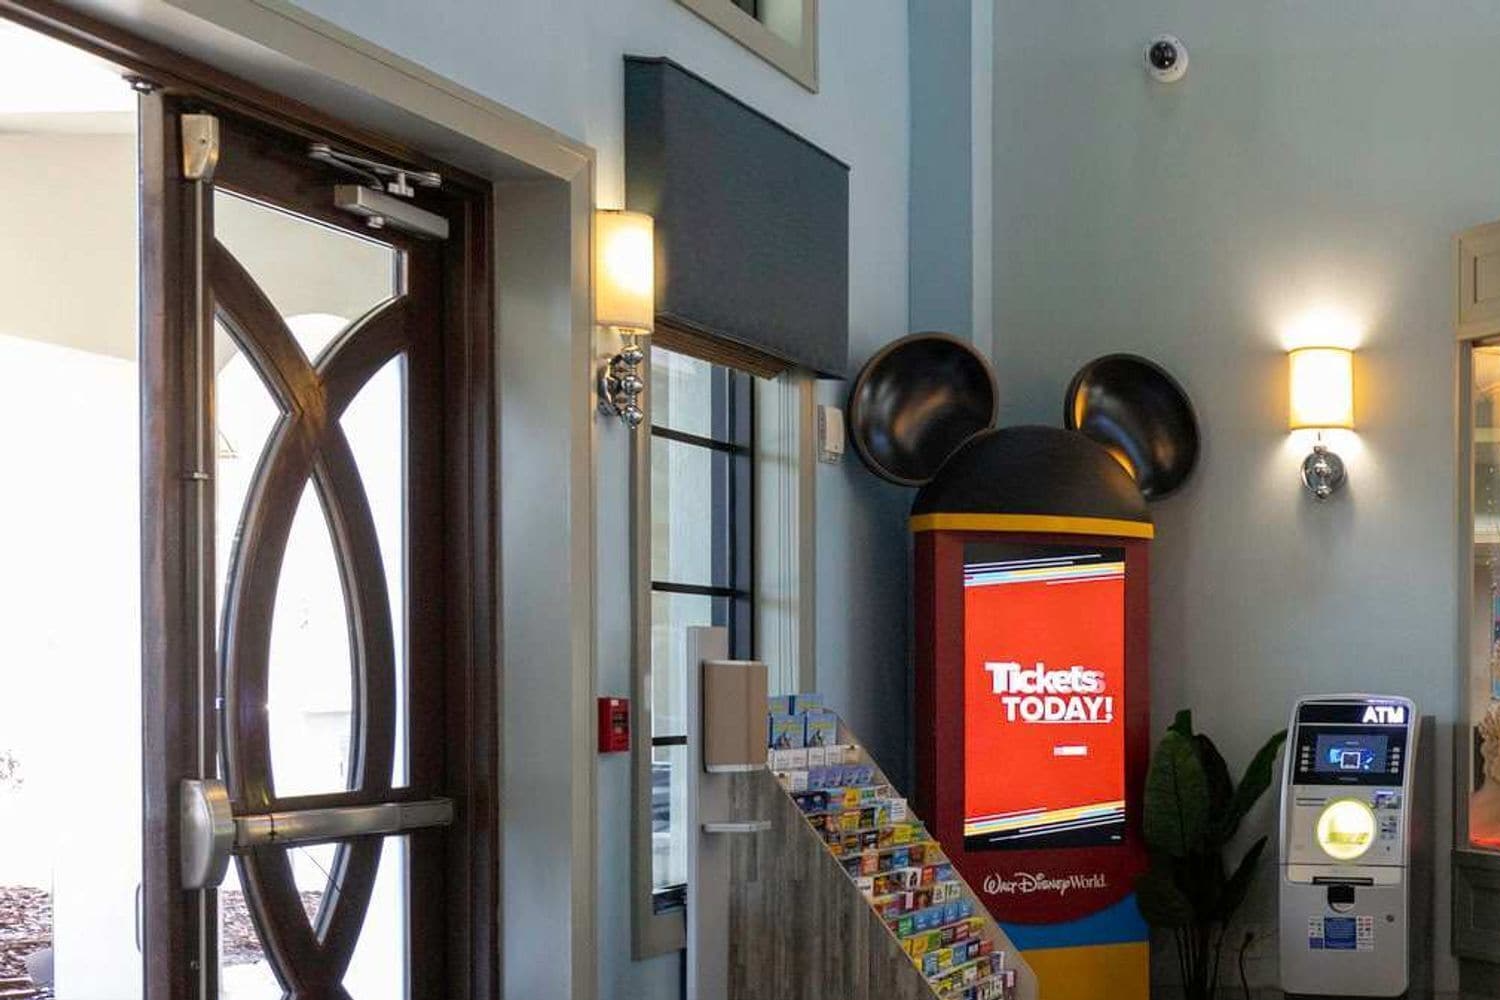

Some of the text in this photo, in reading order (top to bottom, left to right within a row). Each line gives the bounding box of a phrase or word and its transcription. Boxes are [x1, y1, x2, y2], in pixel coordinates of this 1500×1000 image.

[984, 661, 1106, 694] Tickets
[1001, 695, 1114, 722] TODAY!
[1362, 705, 1404, 723] ATM
[983, 873, 1017, 895] Walt
[1014, 872, 1070, 896] Disney
[1069, 873, 1106, 889] World
